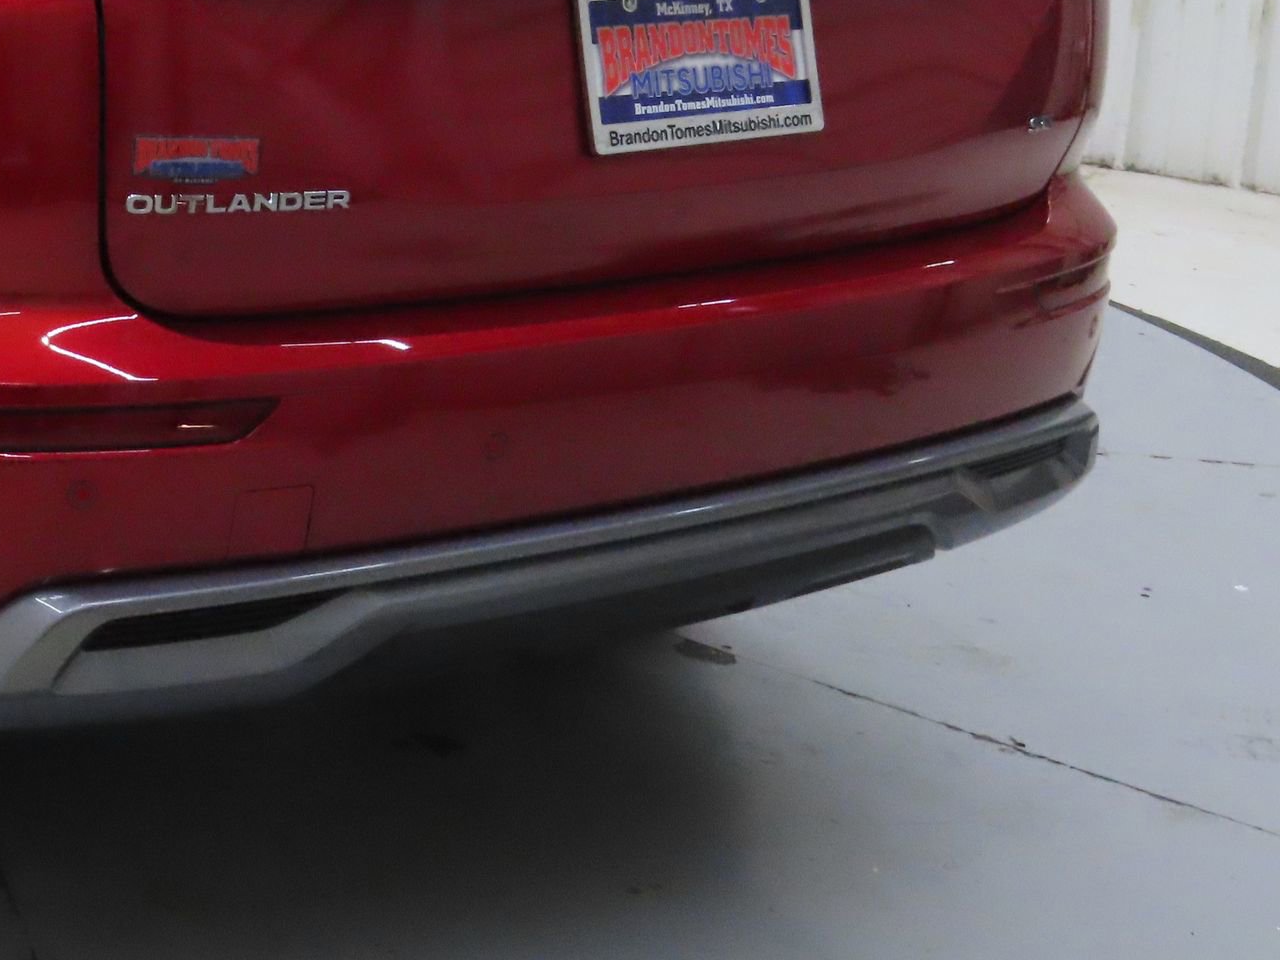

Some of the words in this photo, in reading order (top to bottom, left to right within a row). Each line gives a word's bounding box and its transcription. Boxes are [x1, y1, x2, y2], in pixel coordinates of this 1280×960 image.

[656, 0, 713, 17] McKinney,
[630, 63, 774, 98] MITSUBISHI
[634, 93, 774, 116] BrandonTomesMitsubishi.com
[609, 113, 812, 147] BrandonTomesMitsubishi.com
[126, 190, 351, 215] OUTLANDER
